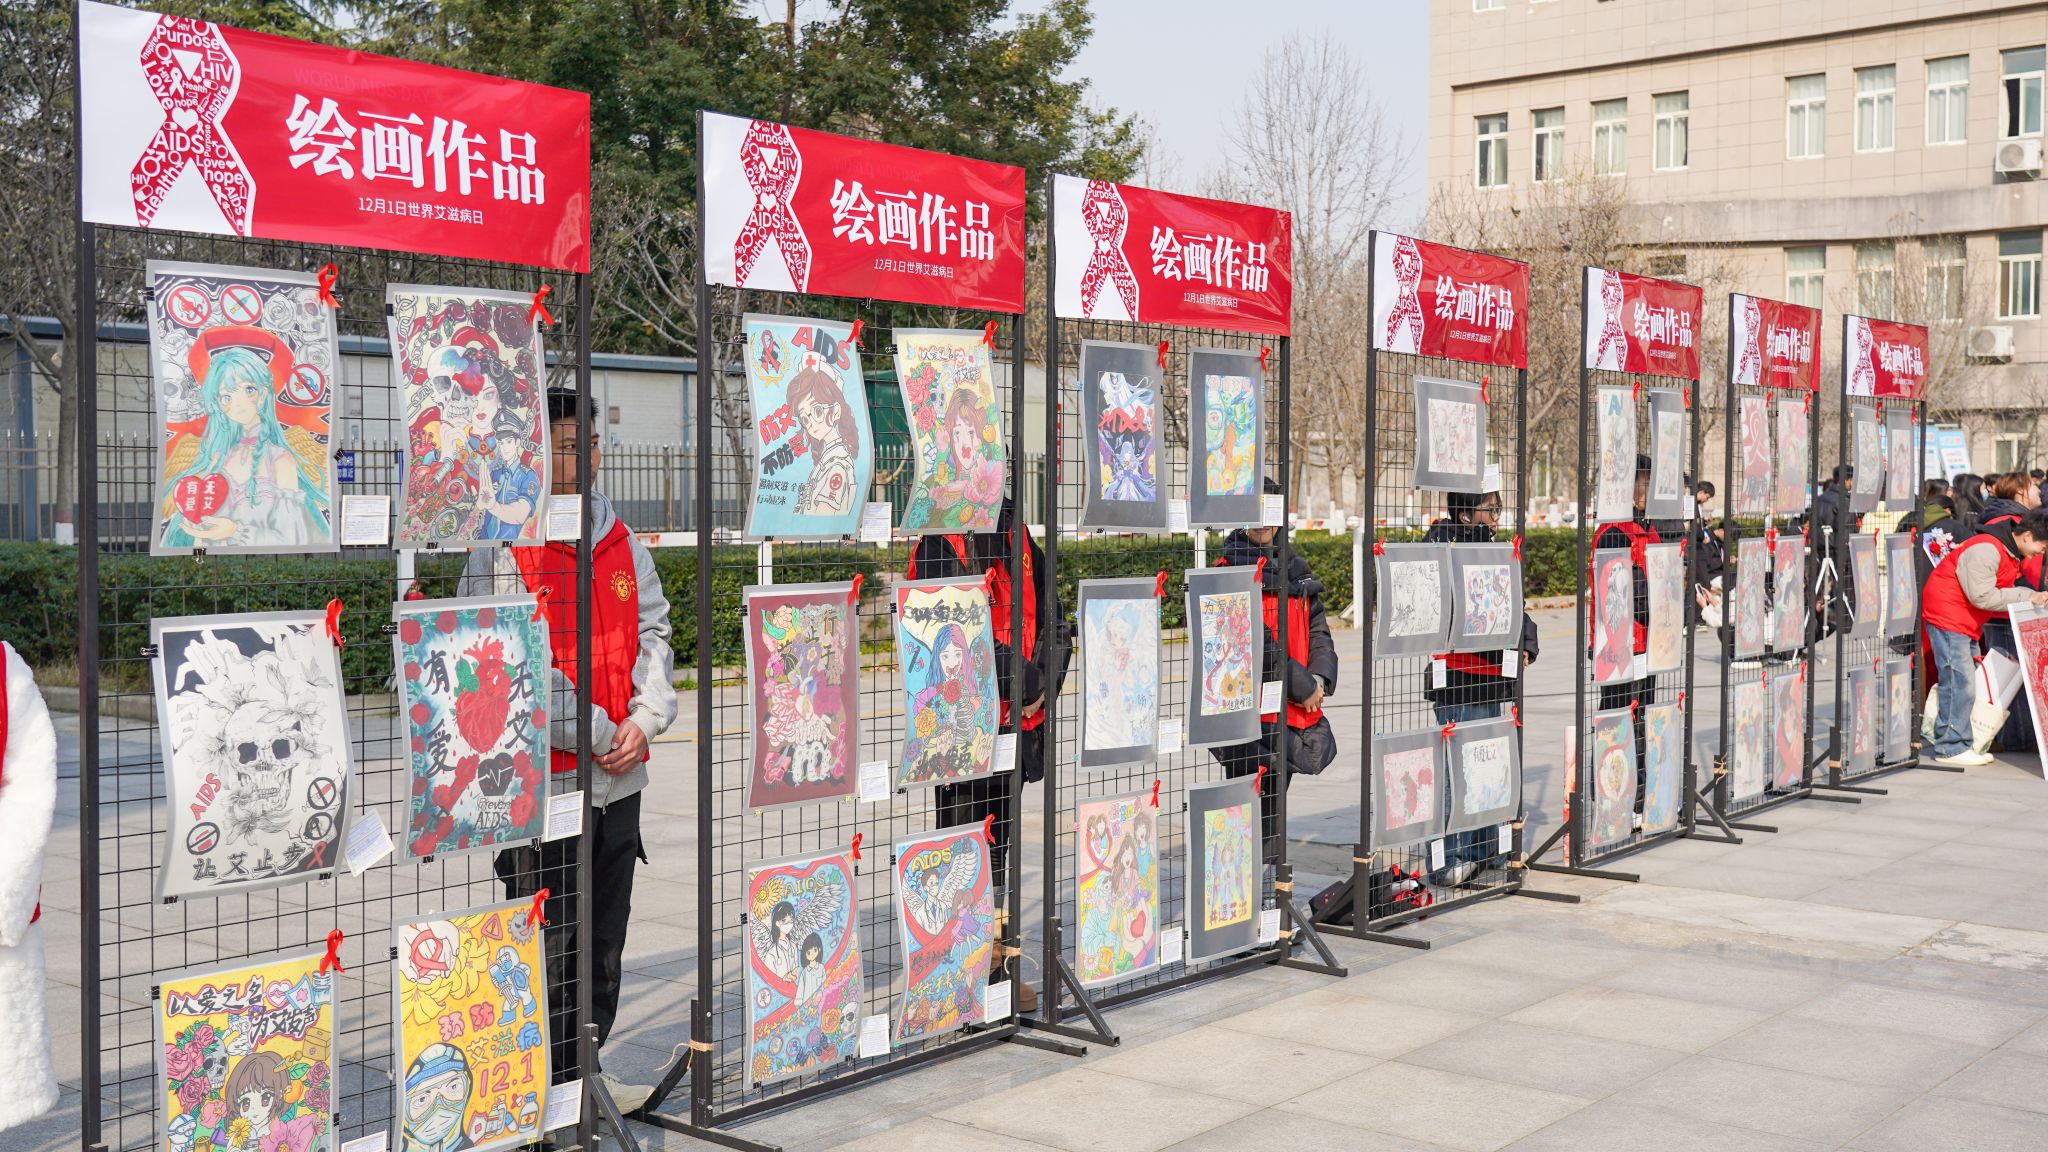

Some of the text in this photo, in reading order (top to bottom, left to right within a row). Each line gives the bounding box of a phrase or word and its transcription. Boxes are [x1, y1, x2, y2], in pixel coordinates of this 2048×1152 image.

[156, 25, 221, 50] Purpose
[177, 23, 191, 31] HIV
[141, 36, 159, 60] Inspire
[158, 67, 172, 83] HIV
[201, 61, 233, 82] HIV
[142, 60, 173, 110] Love
[182, 80, 208, 94] Health
[174, 98, 198, 108] hope
[201, 85, 229, 124] Inspire
[152, 129, 205, 154] AIDS
[285, 93, 545, 205] 绘画作品
[748, 129, 790, 146] Purpose
[196, 155, 225, 169] Love
[777, 156, 798, 171] HIV
[131, 173, 150, 185] HIV
[204, 167, 243, 187] hope
[742, 157, 761, 195] Love
[778, 174, 795, 204] Inspire
[138, 166, 181, 221] Health
[225, 186, 246, 215] AIDS
[1087, 187, 1117, 200] Purpose
[358, 197, 484, 225] 12月1日世界艾滋病日
[748, 210, 780, 228] AIDS
[830, 178, 995, 260] 绘画作品
[1109, 208, 1125, 220] HIV
[775, 229, 793, 239] Love
[780, 239, 805, 253] hope
[737, 239, 766, 281] Health
[792, 253, 805, 276] AIDS
[873, 258, 954, 278] 12月1日世界艾滋病日
[1090, 254, 1115, 269] AIDS
[1150, 225, 1269, 293] 绘画作品
[1084, 277, 1105, 314] Health
[1115, 277, 1133, 288] hope
[1435, 274, 1514, 331] 绘画作品
[1633, 301, 1692, 348] 绘画作品
[791, 326, 850, 371] AIDS
[1766, 322, 1811, 363] 绘画作品
[1880, 340, 1924, 377] 绘画作品
[188, 772, 221, 822] AIDS
[911, 847, 953, 872] AIDS
[784, 871, 826, 900] AIDS
[170, 981, 263, 1013] 以爱之名
[438, 1001, 495, 1042] 预防
[466, 1021, 542, 1070] 艾滋病
[479, 1052, 534, 1098] 12.1
